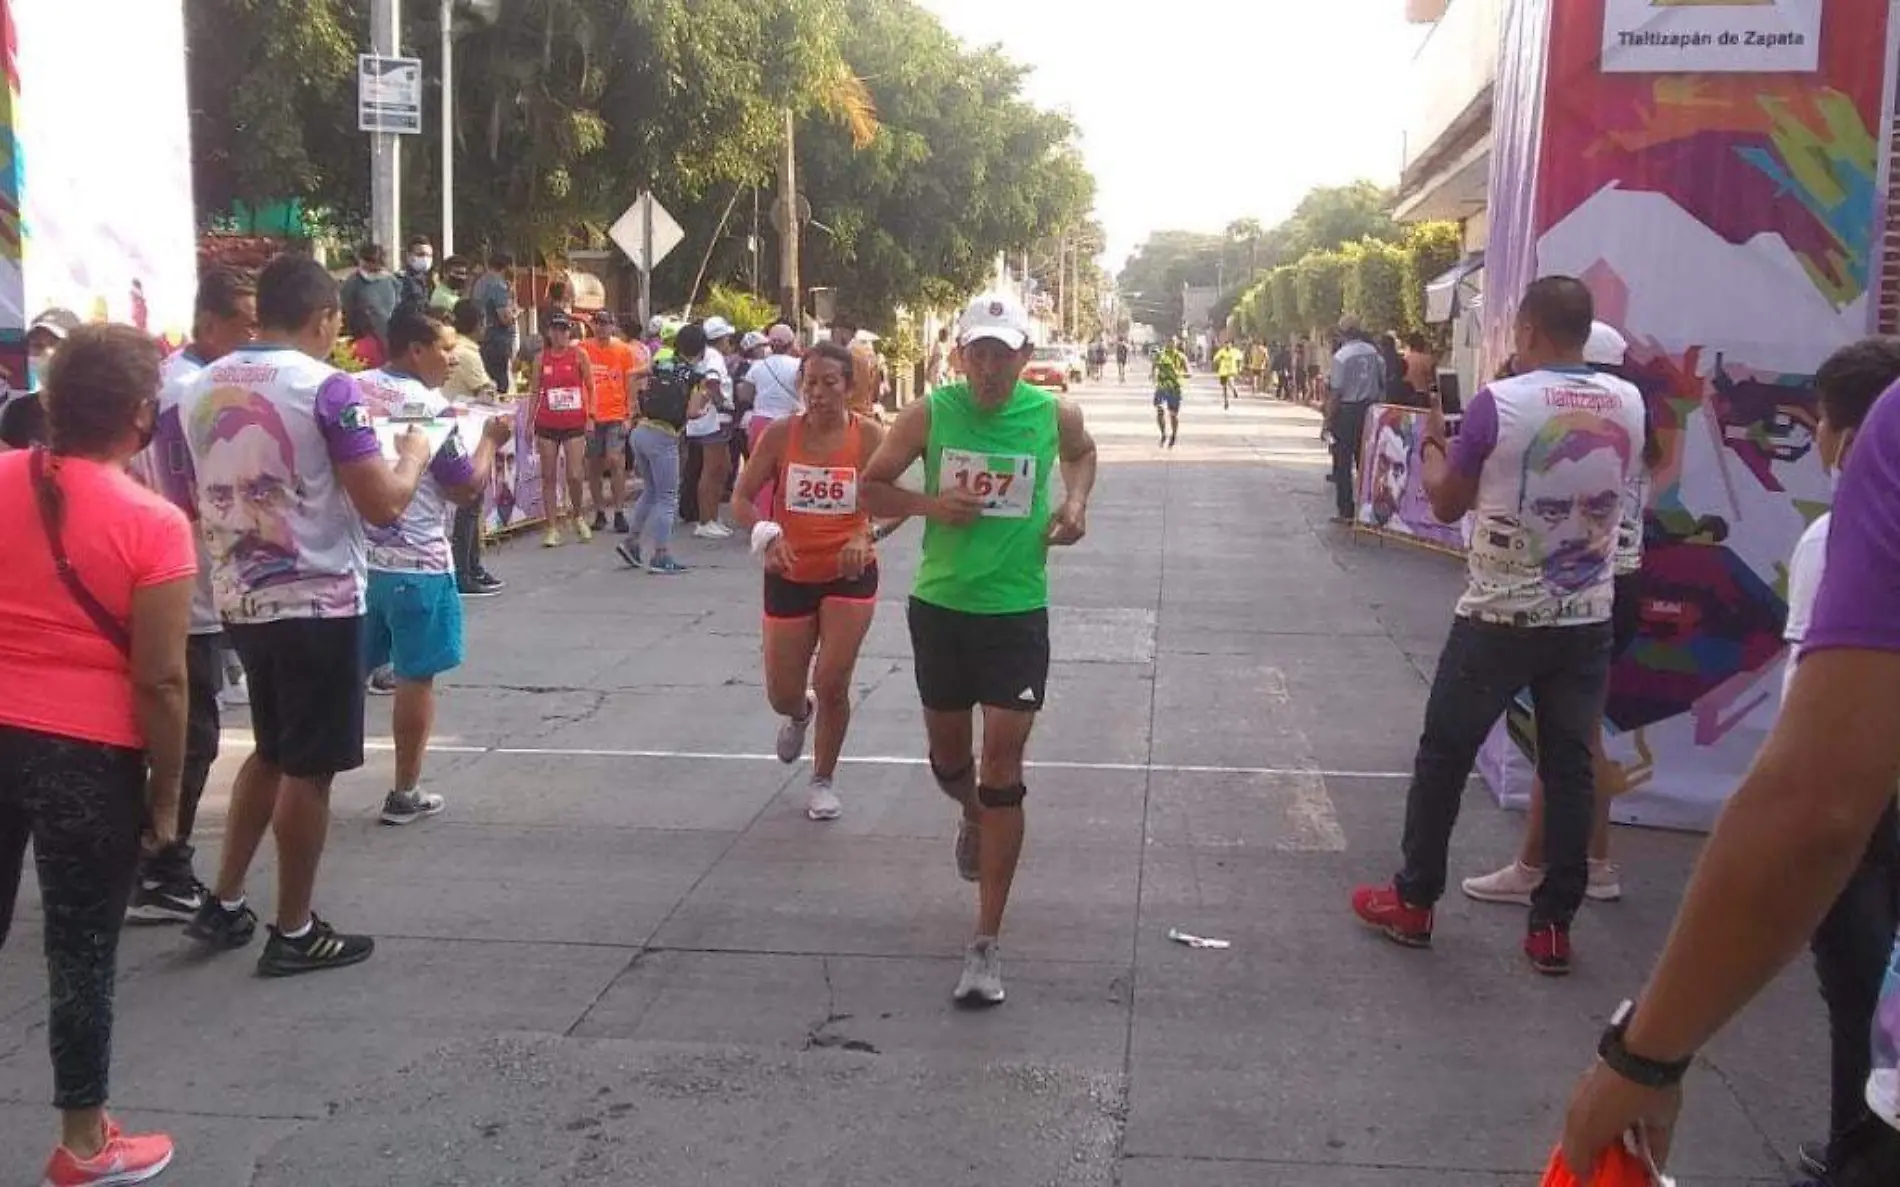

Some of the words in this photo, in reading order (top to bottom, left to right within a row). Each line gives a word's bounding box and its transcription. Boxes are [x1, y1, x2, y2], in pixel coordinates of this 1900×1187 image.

[1618, 31, 1711, 50] Tlaltizapán
[1717, 32, 1739, 46] de
[1744, 31, 1804, 48] Zapata
[799, 480, 844, 500] 266
[955, 470, 1014, 496] 167
